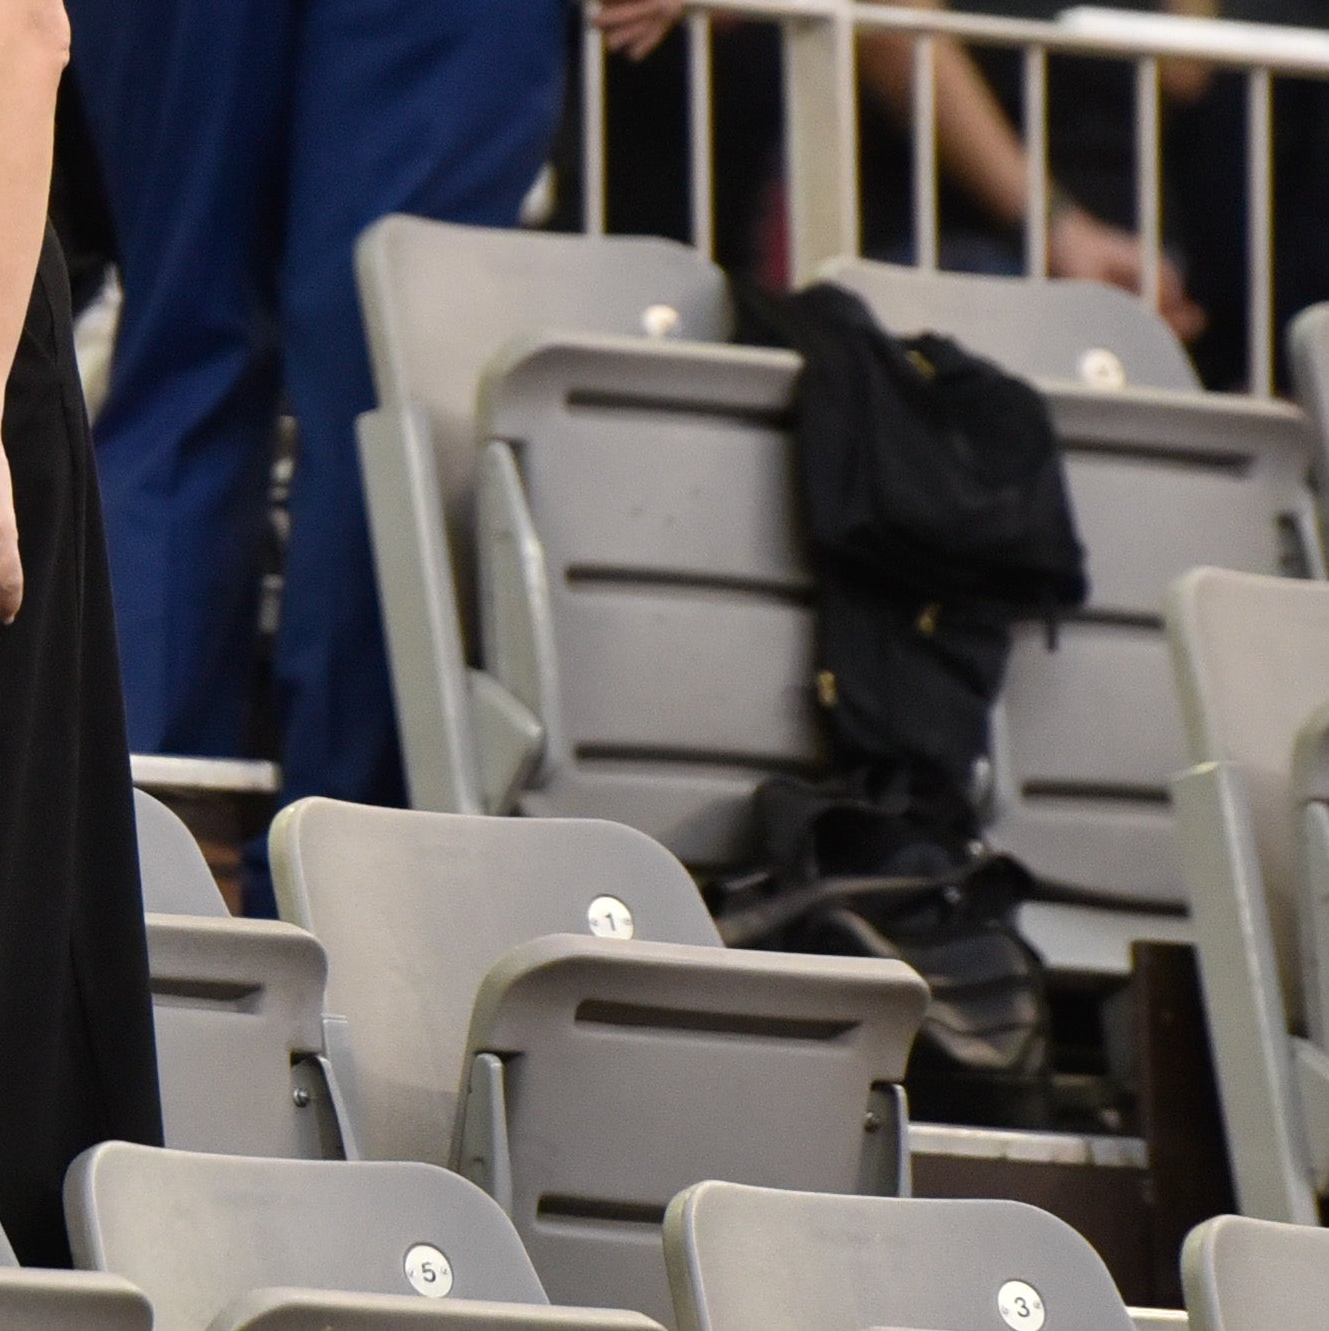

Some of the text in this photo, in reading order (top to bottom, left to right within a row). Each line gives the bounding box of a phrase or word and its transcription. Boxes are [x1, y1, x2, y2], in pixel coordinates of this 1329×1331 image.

[604, 911, 617, 932] 1
[421, 1261, 437, 1283] 5
[1013, 1296, 1031, 1319] 3
